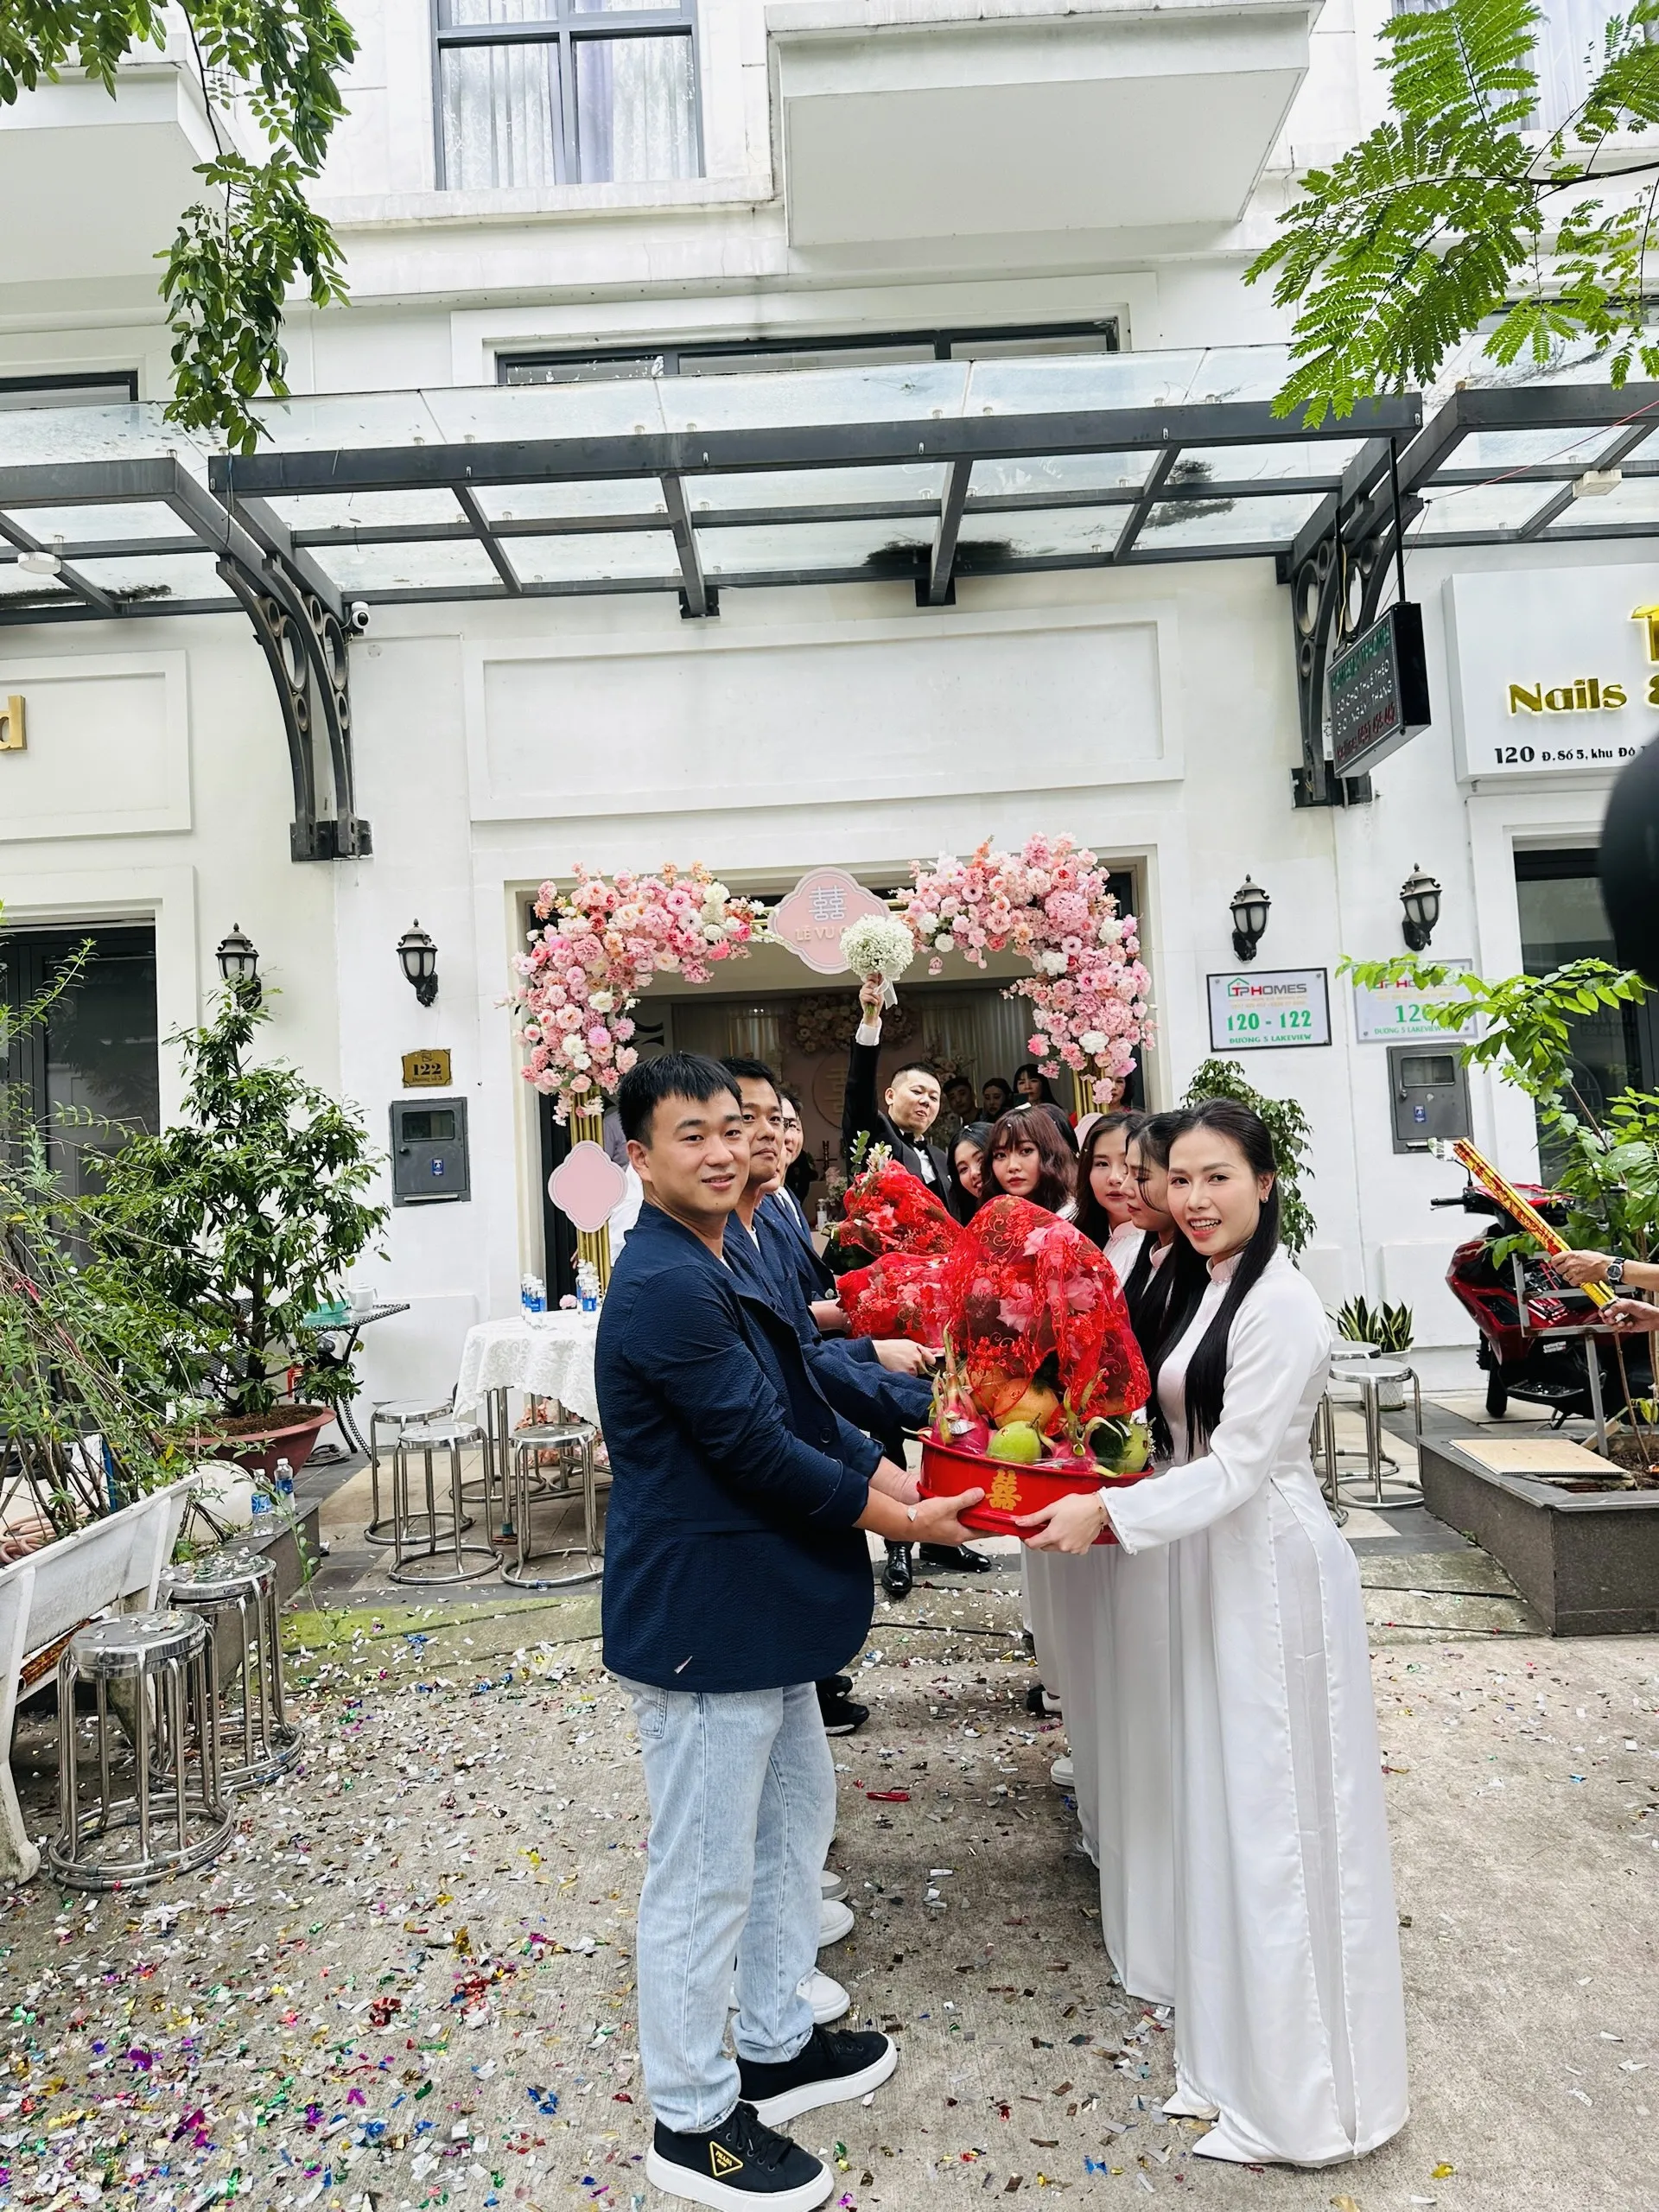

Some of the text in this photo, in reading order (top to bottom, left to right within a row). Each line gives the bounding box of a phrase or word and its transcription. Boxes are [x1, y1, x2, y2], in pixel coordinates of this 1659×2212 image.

[1509, 678, 1627, 714] Nails
[1494, 746, 1535, 764] 120
[1592, 748, 1613, 759] khu
[1618, 747, 1636, 757] Đô
[1227, 1013, 1260, 1031] 120
[1280, 1010, 1312, 1028] 122
[1271, 1033, 1312, 1042] LAKEVIEW
[414, 1063, 442, 1076] 122
